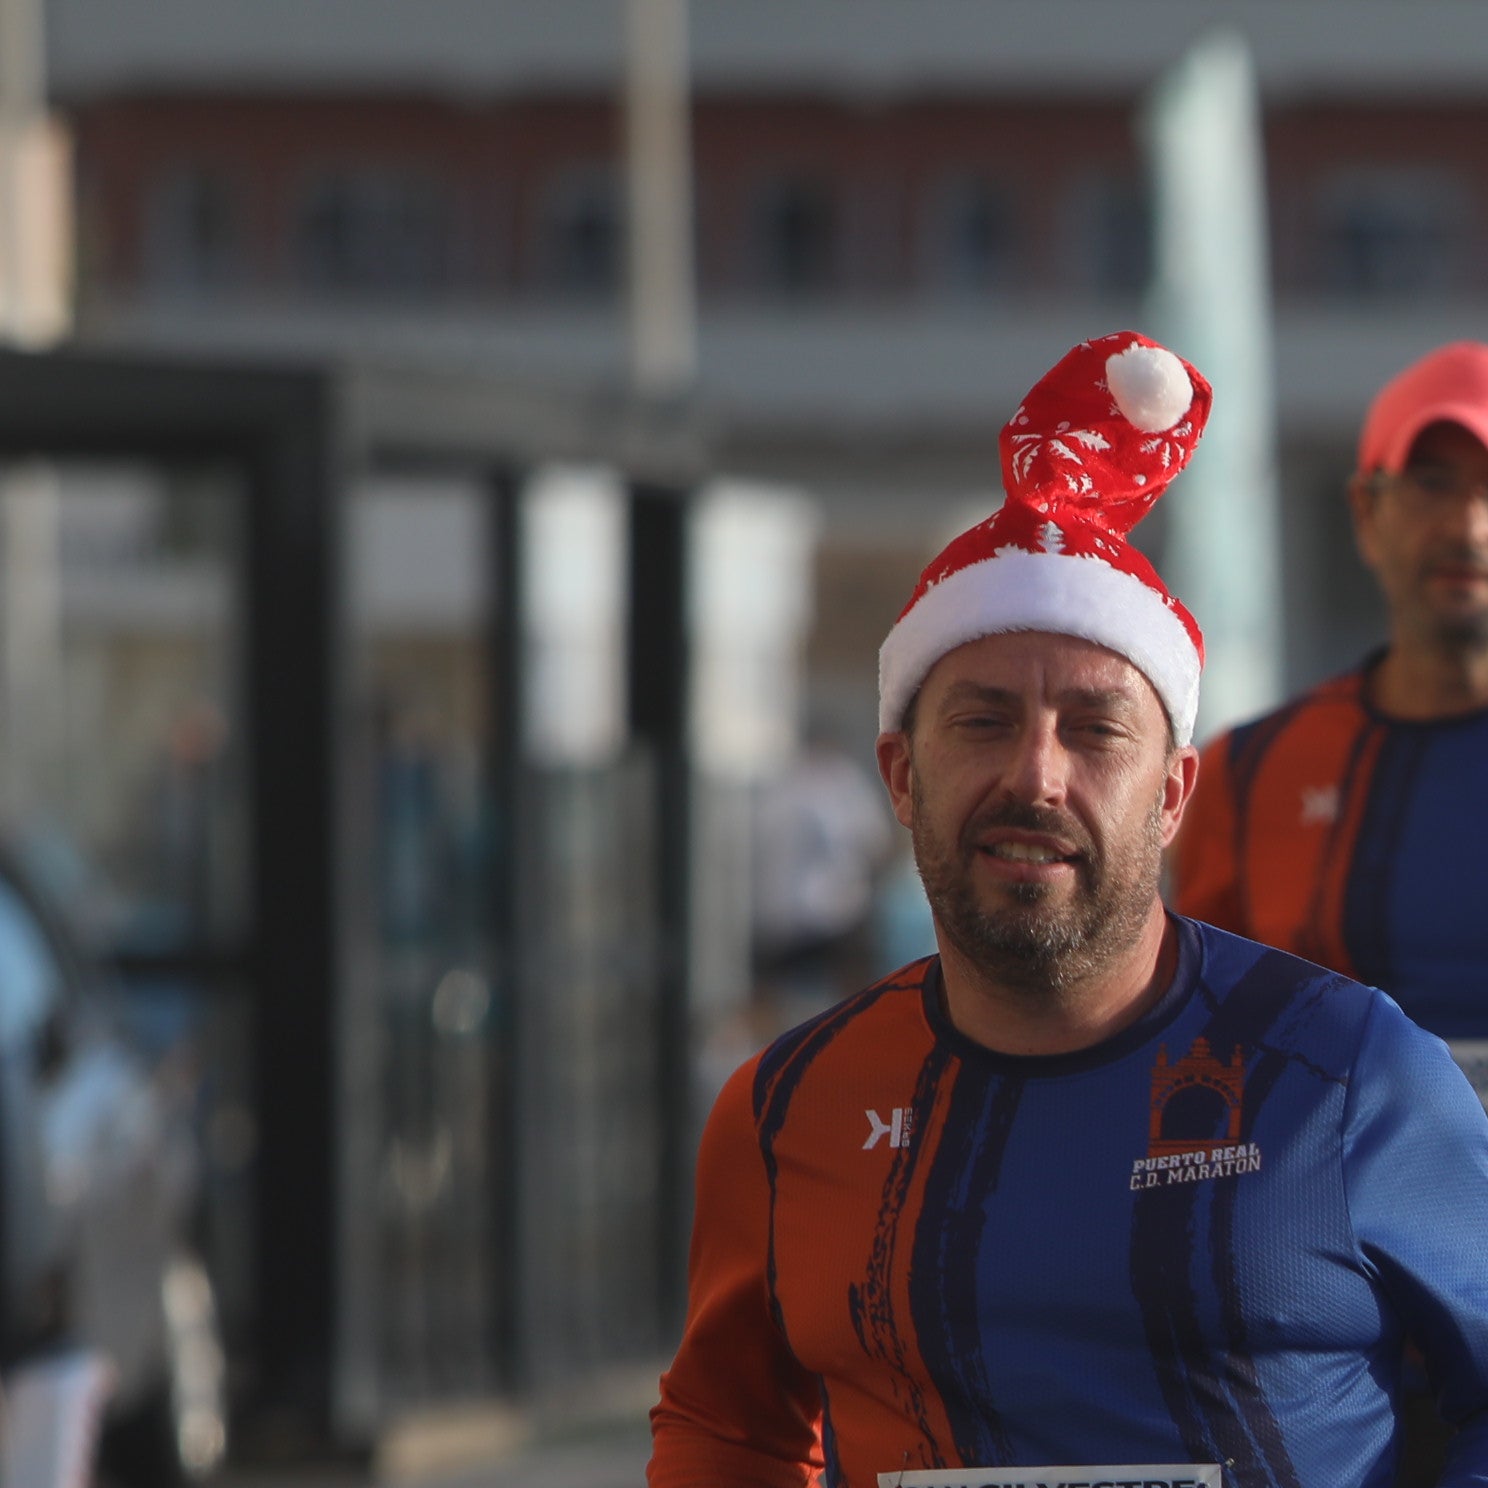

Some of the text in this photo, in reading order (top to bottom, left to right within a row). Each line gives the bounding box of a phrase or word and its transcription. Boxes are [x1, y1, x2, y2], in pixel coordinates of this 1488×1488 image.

[1130, 1155, 1261, 1191] C.D. MARATON
[1132, 1142, 1260, 1174] PUERTO REAL
